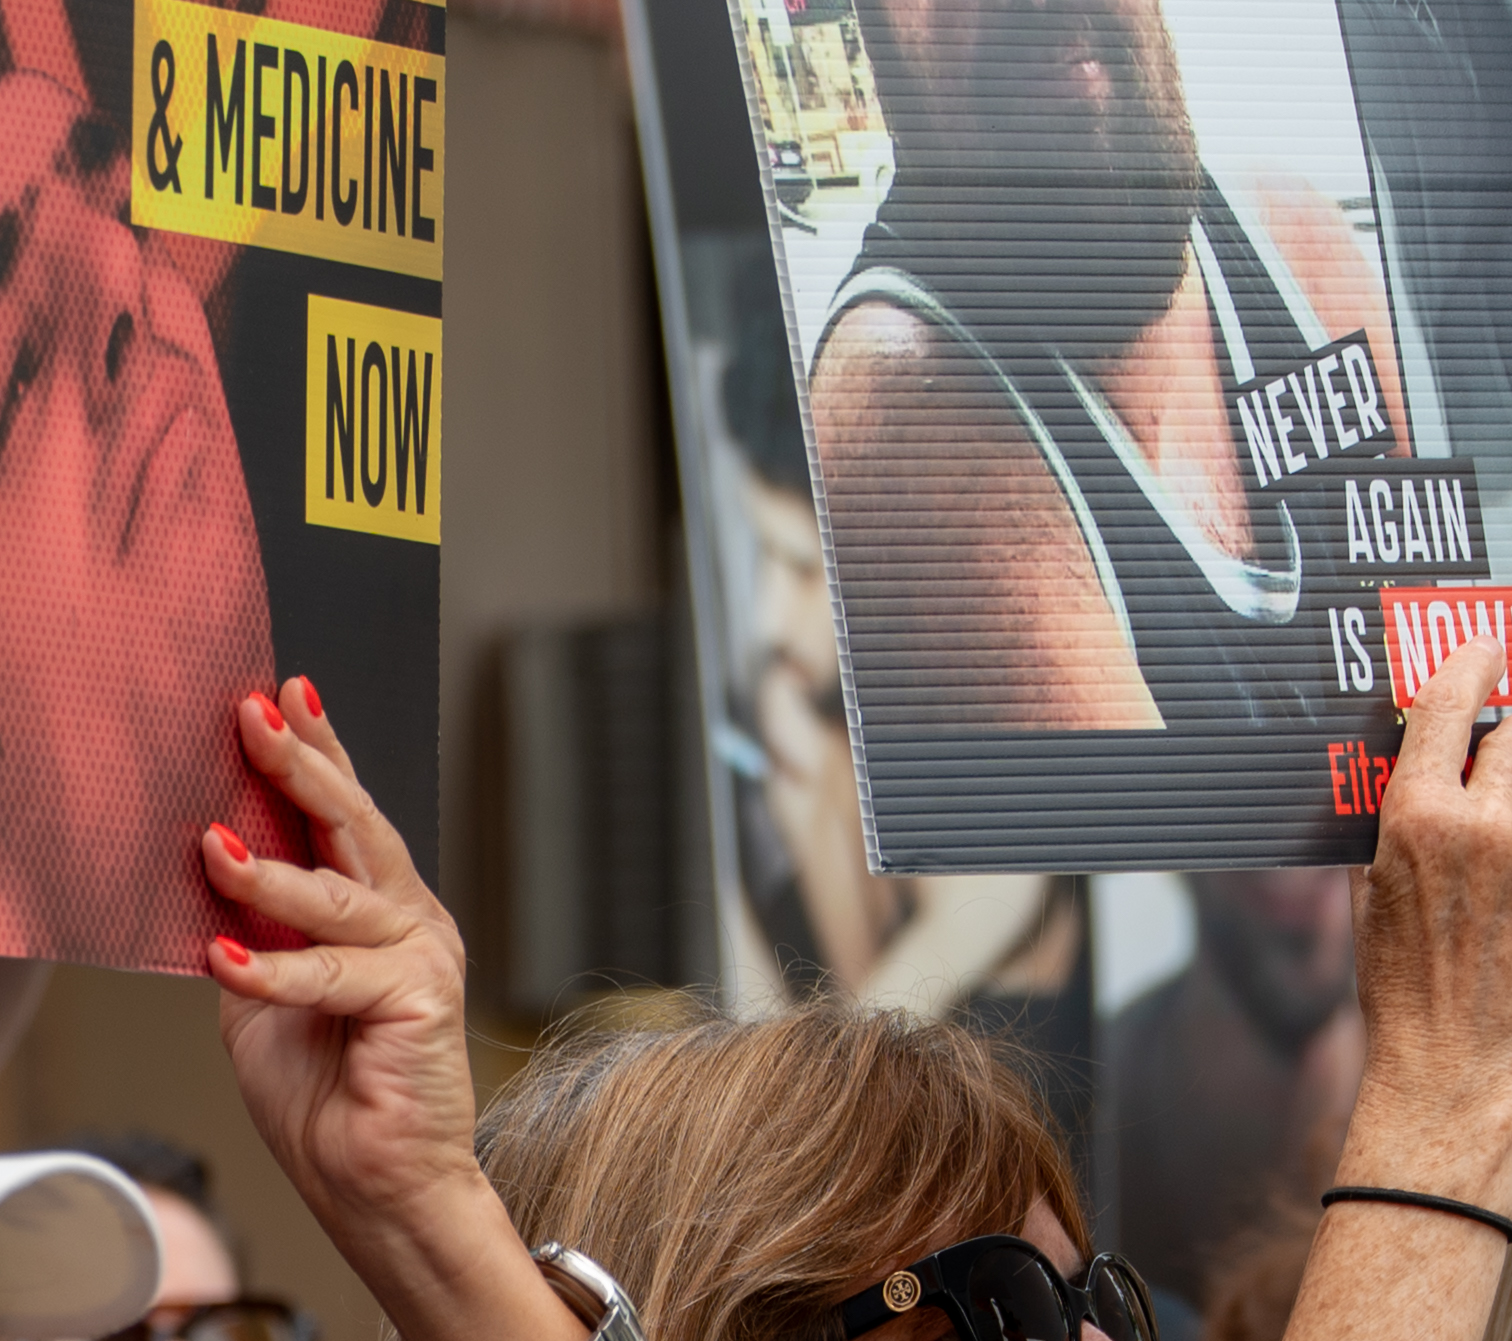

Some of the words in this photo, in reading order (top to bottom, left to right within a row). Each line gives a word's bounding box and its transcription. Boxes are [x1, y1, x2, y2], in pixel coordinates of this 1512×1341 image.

[147, 39, 183, 194] &
[204, 32, 437, 244] MEDICINE
[325, 333, 433, 516] NOW
[1236, 343, 1387, 488] NEVER
[1344, 478, 1472, 563] AGAIN
[1328, 607, 1374, 692] IS
[1328, 741, 1396, 815] Eita
